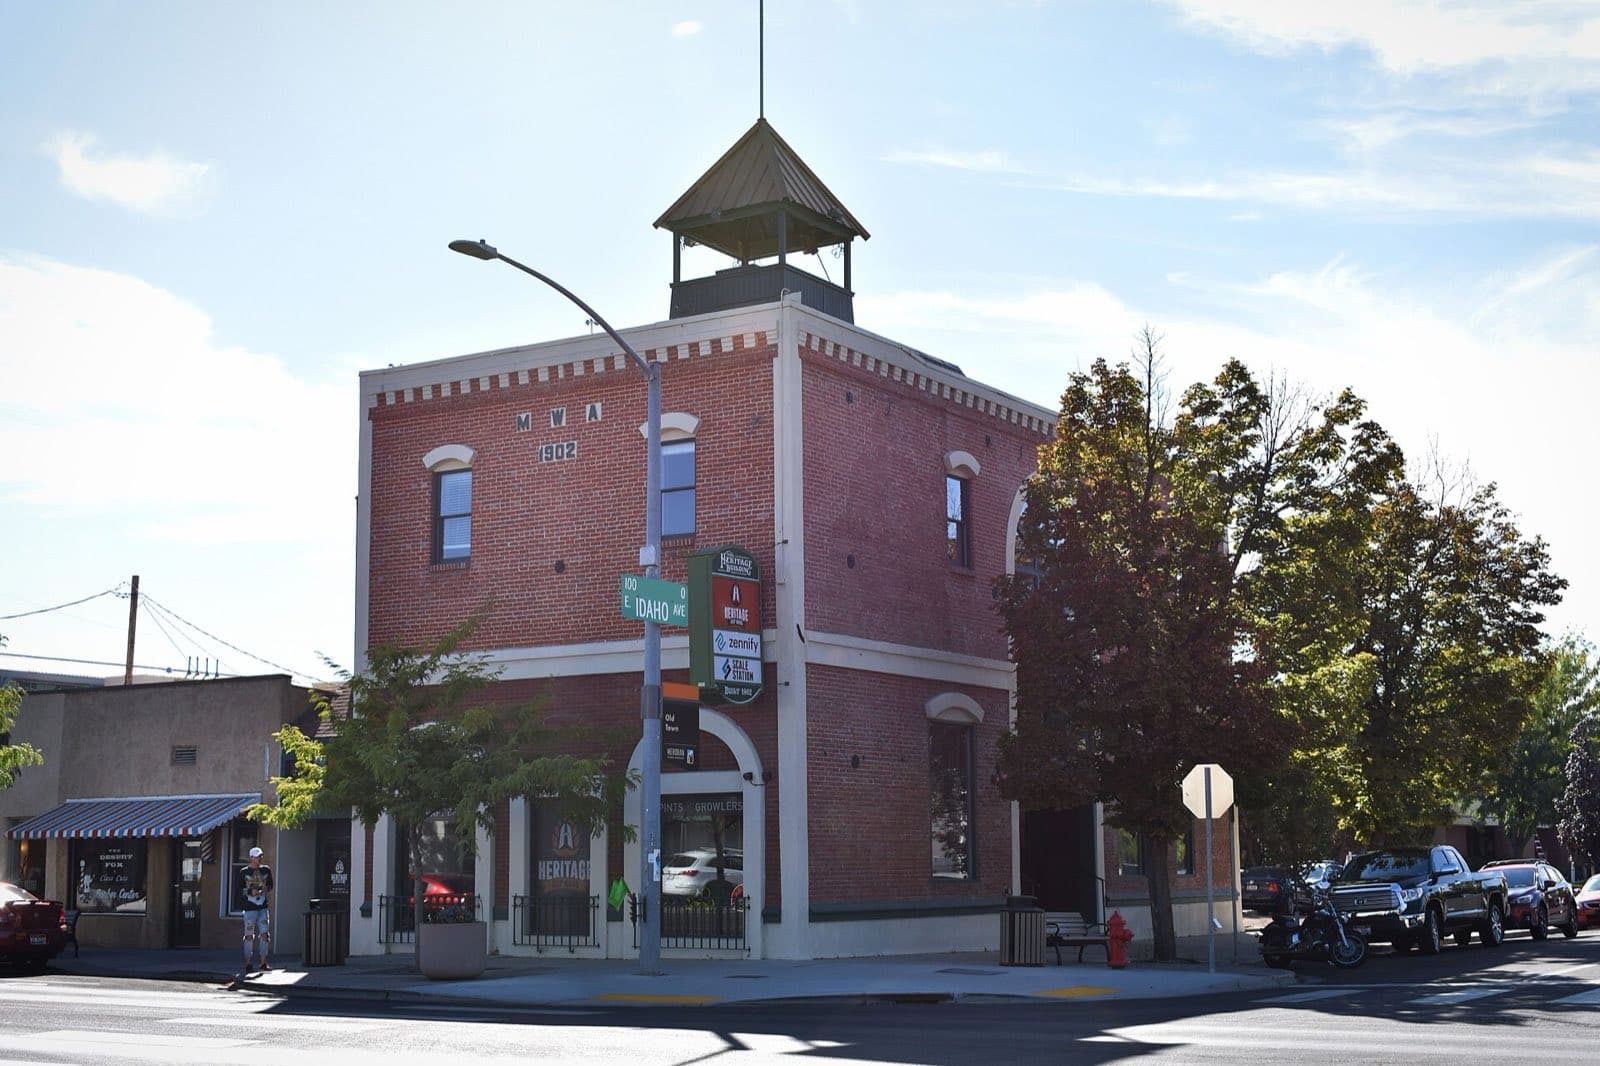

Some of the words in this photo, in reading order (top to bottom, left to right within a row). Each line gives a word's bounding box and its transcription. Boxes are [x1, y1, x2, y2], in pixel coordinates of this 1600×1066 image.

[517, 414, 529, 431] M
[552, 409, 564, 426] W
[588, 404, 598, 421] A
[540, 442, 575, 462] 1902
[720, 552, 752, 569] HERITAGE
[726, 564, 752, 576] BUILDING
[625, 577, 637, 591] 100
[635, 597, 669, 621] IDAHO
[672, 603, 686, 617] AVE
[724, 606, 749, 622] HERITAGE
[729, 637, 759, 653] zennify
[732, 659, 749, 671] SCALE
[732, 670, 754, 681] STATION
[665, 713, 675, 722] Old
[665, 723, 679, 732] Town
[695, 801, 743, 812] GROWLERS
